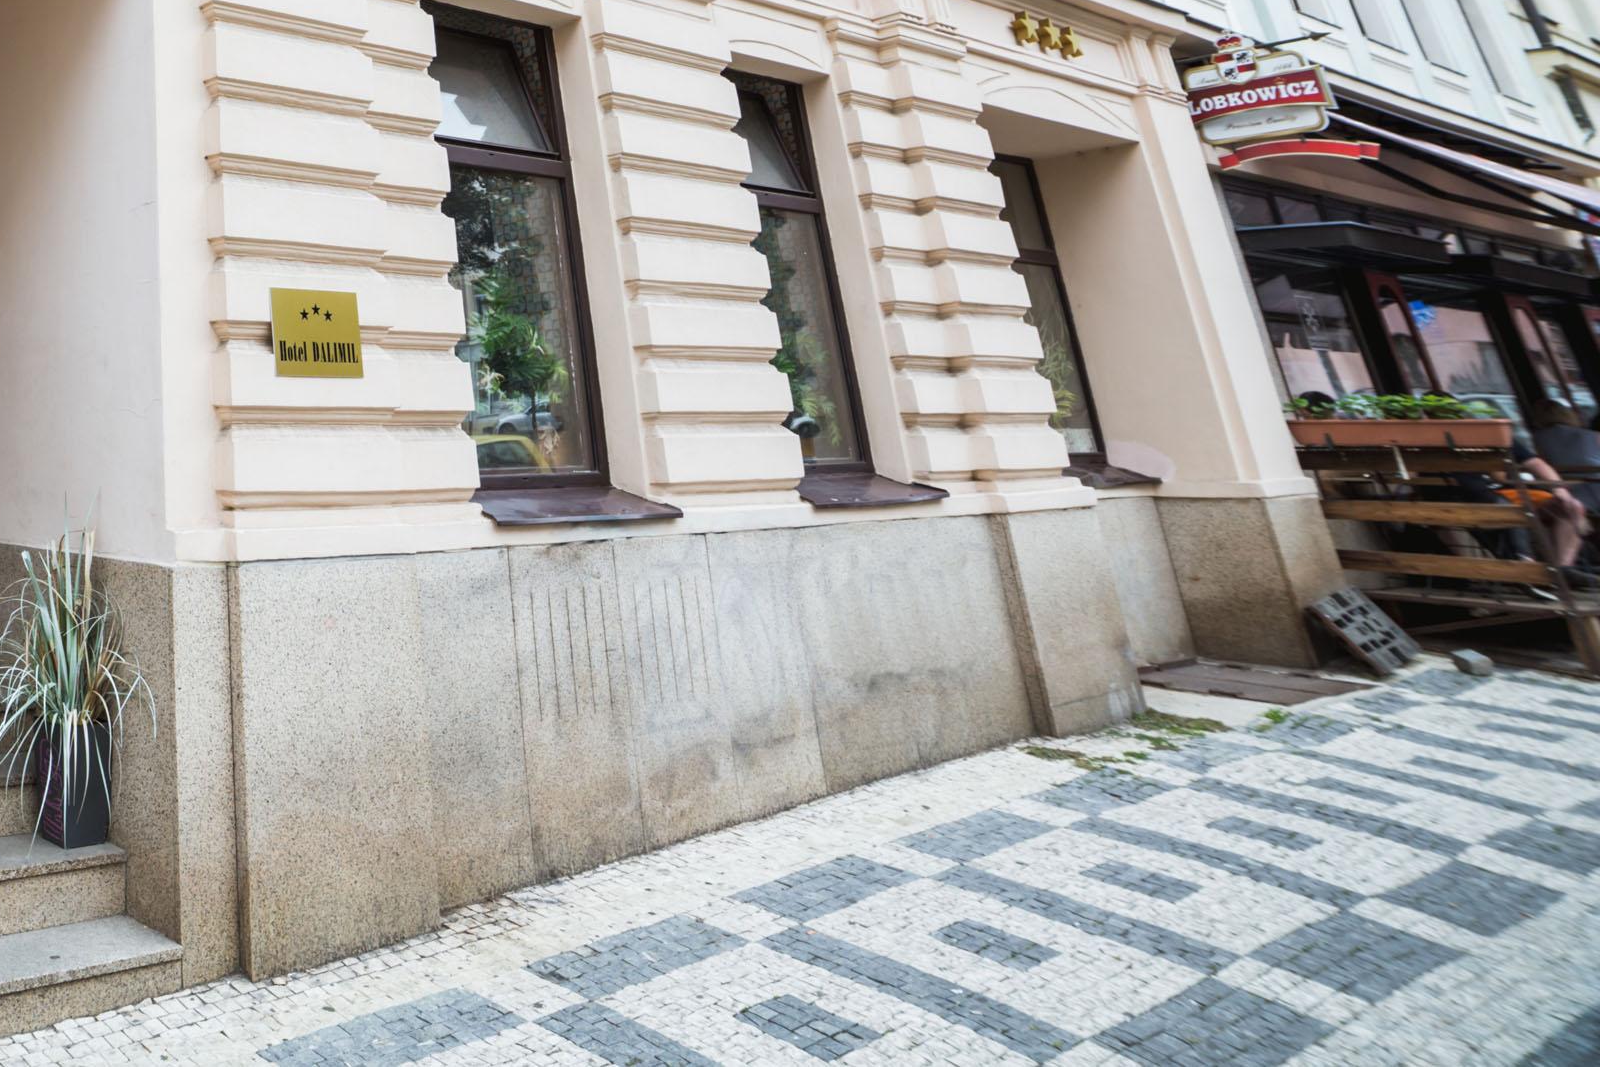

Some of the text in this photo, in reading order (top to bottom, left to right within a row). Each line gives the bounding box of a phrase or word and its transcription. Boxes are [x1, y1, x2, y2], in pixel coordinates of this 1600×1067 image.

[1189, 80, 1318, 115] LOBKOWICZ
[279, 340, 359, 364] Hotel DALIMIL
